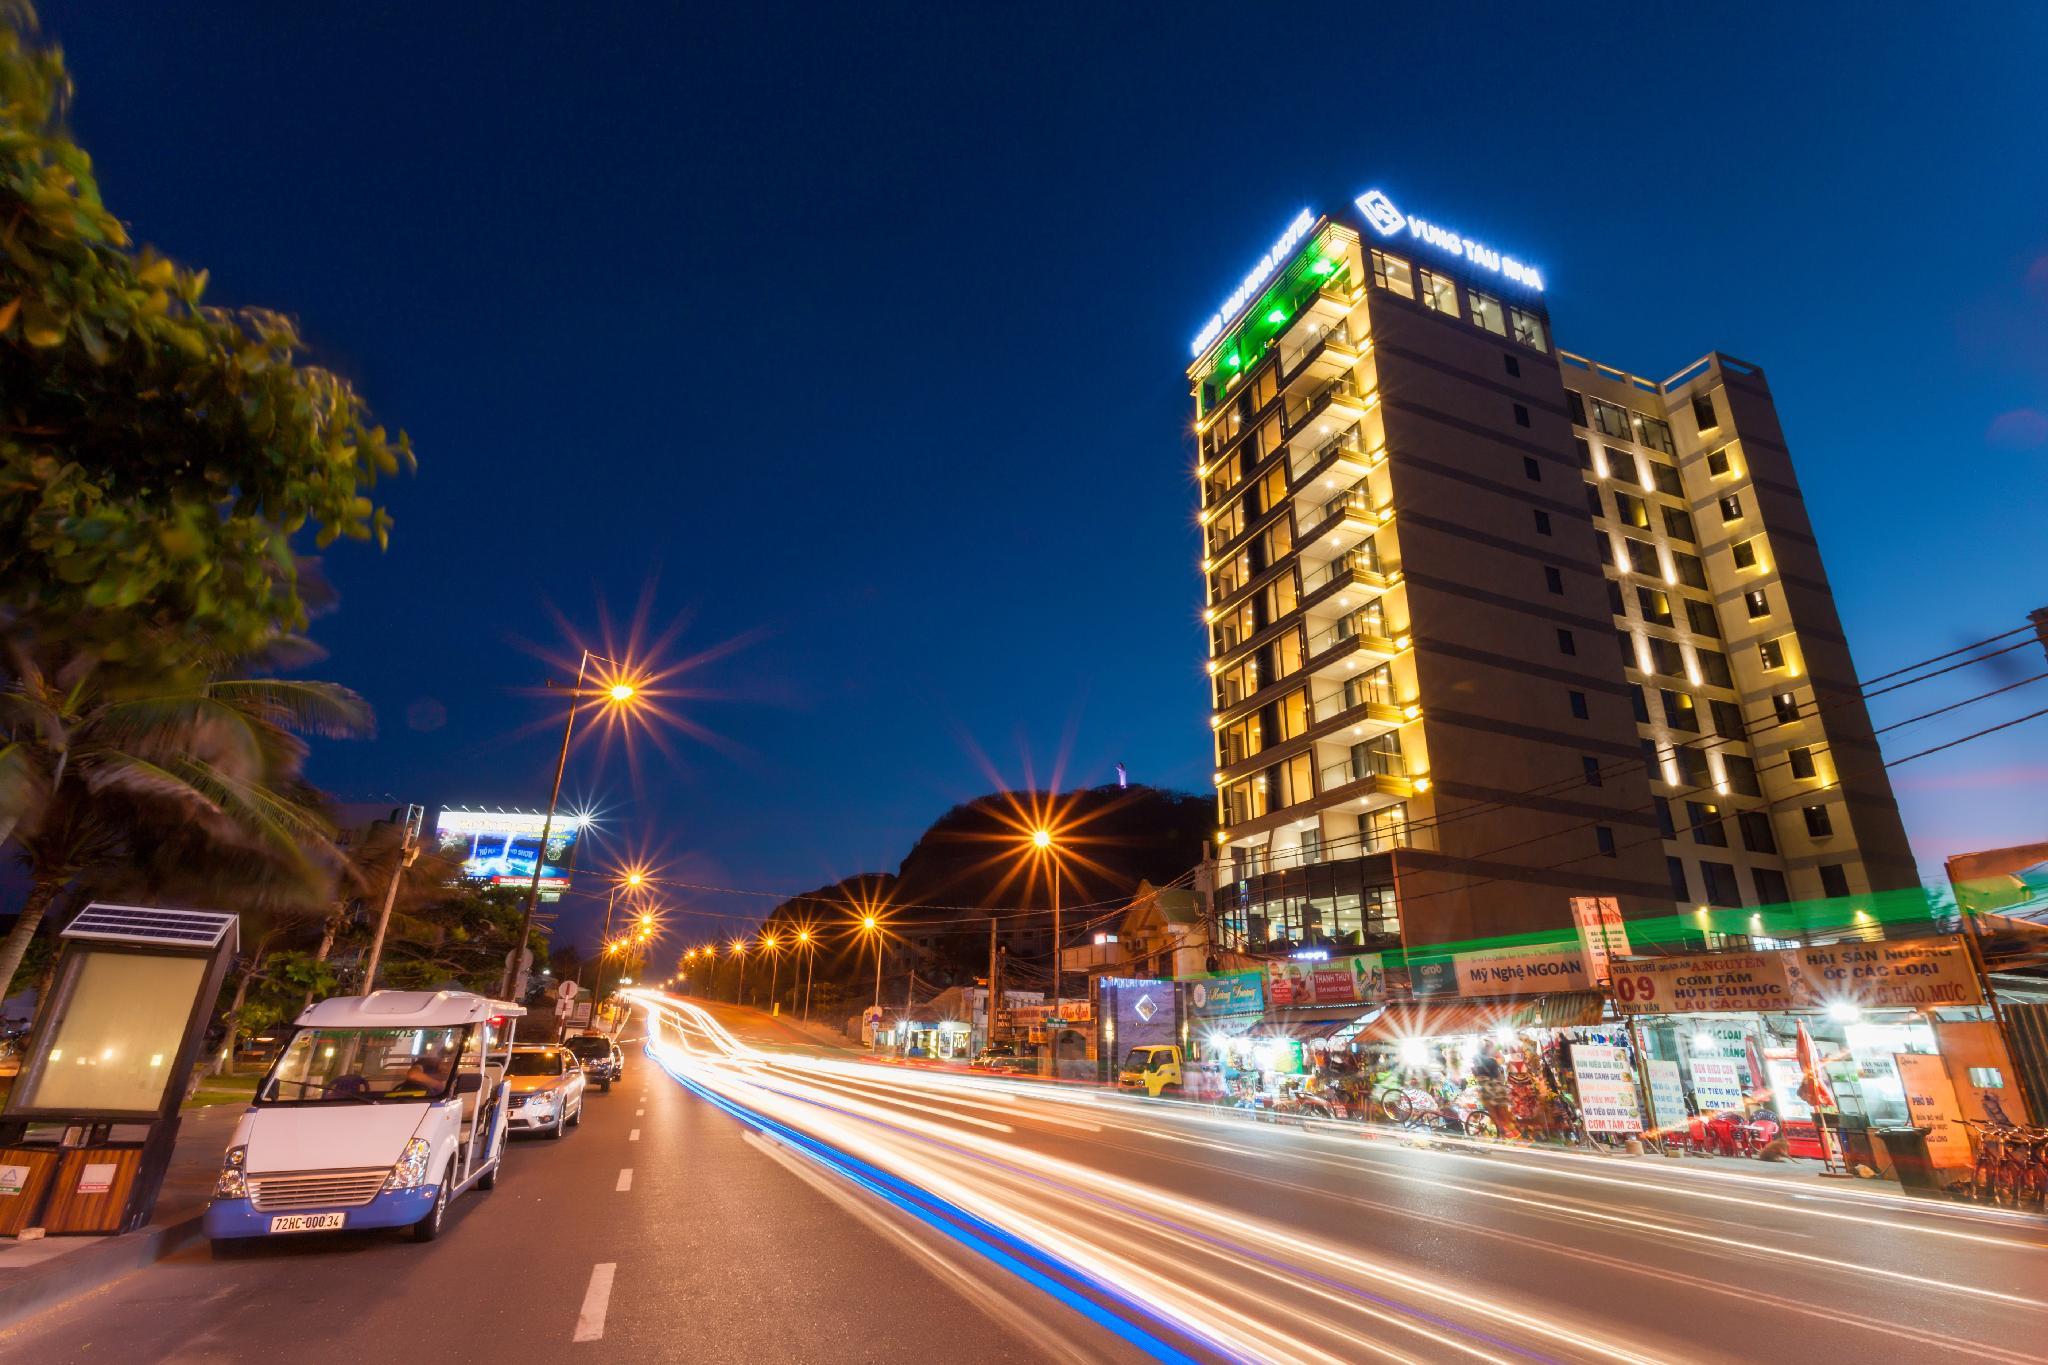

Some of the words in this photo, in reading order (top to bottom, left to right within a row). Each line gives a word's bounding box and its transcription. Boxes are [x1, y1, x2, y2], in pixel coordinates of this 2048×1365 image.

[1407, 215, 1463, 255] VUNG
[1463, 239, 1500, 272] TAU
[1470, 968, 1488, 983] Mỹ
[1491, 963, 1523, 982] Nghệ
[1527, 960, 1581, 977] NGOAN
[1853, 963, 1889, 978] CÁC
[1895, 962, 1939, 977] LOẠI
[1676, 974, 1713, 986] CƠM
[1617, 976, 1656, 1002] 09
[1741, 984, 1782, 997] MỰC
[276, 1215, 339, 1230] 72HC-000.34
